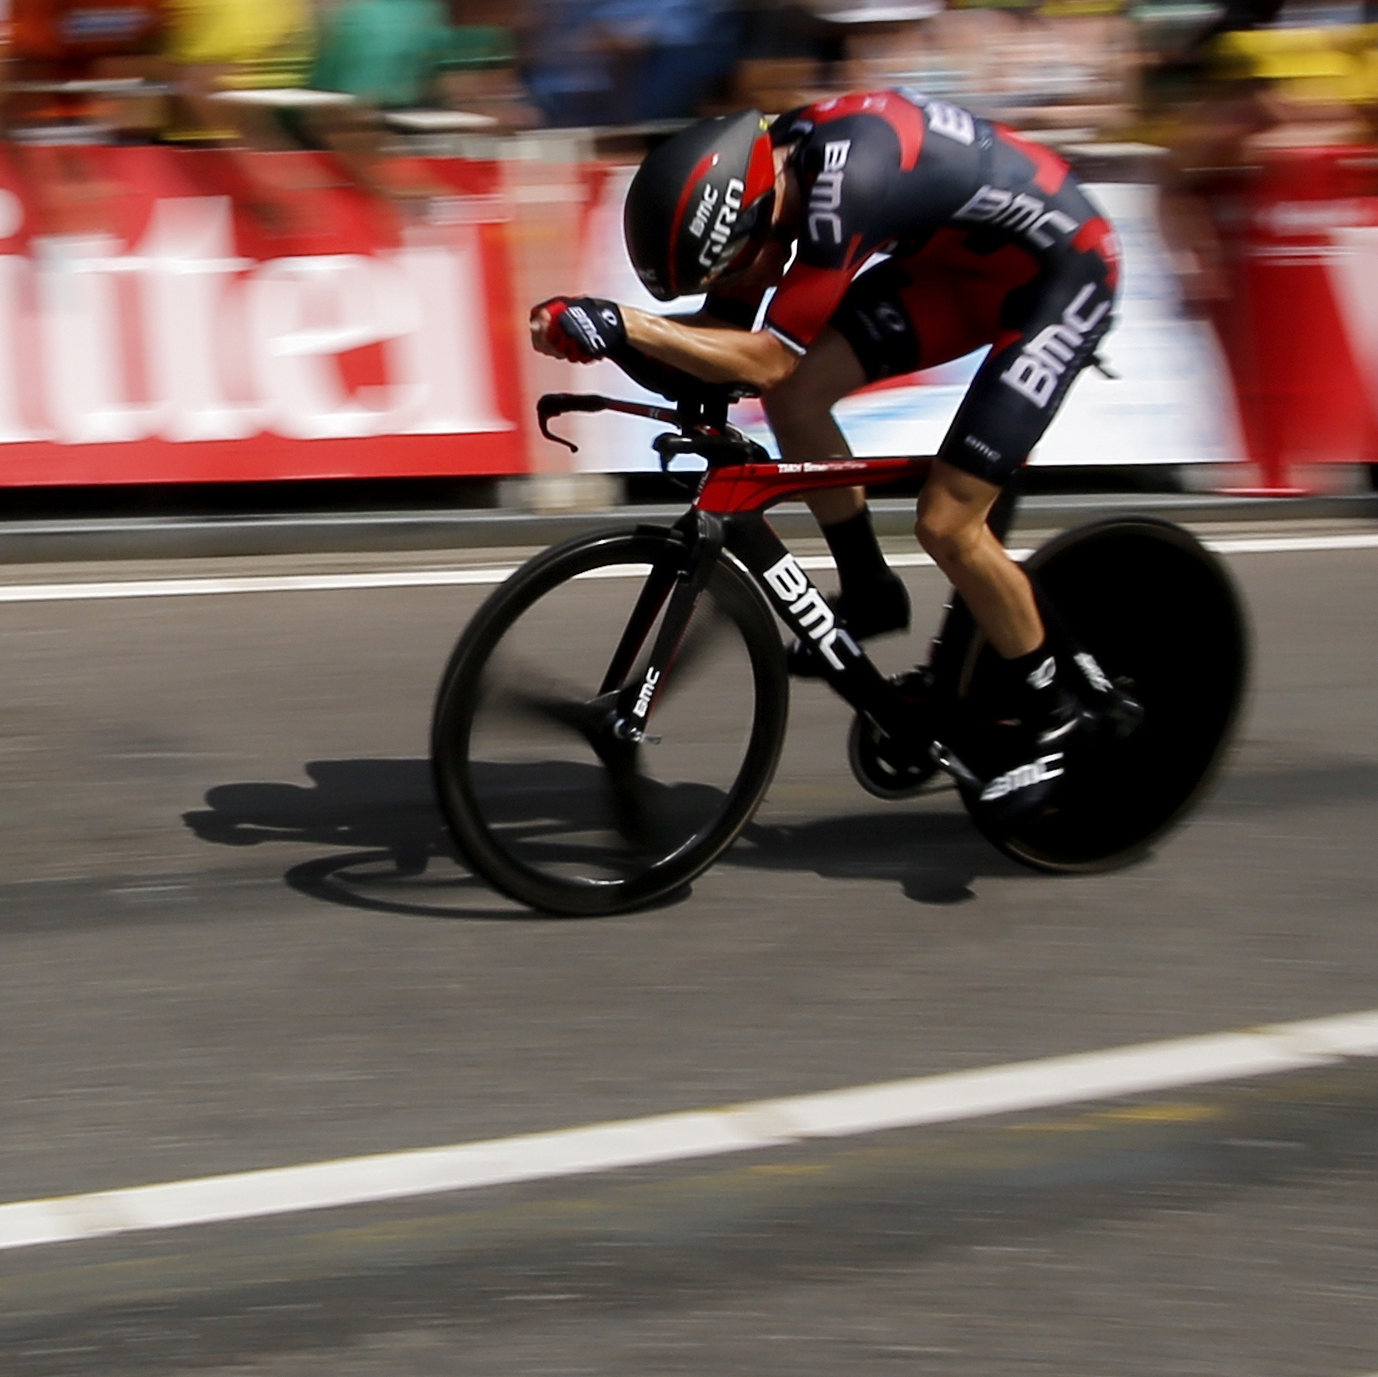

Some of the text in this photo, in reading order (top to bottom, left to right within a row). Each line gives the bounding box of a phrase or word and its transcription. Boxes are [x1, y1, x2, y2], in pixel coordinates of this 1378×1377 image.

[689, 183, 719, 238] BMC
[699, 178, 744, 267] GIRO
[809, 139, 850, 244] BMC
[952, 185, 1079, 249] BMC
[568, 306, 606, 350] BMC
[1000, 282, 1111, 409] BMC
[763, 553, 862, 670] BMC
[633, 666, 660, 718] BMC
[980, 752, 1064, 801] BMC
